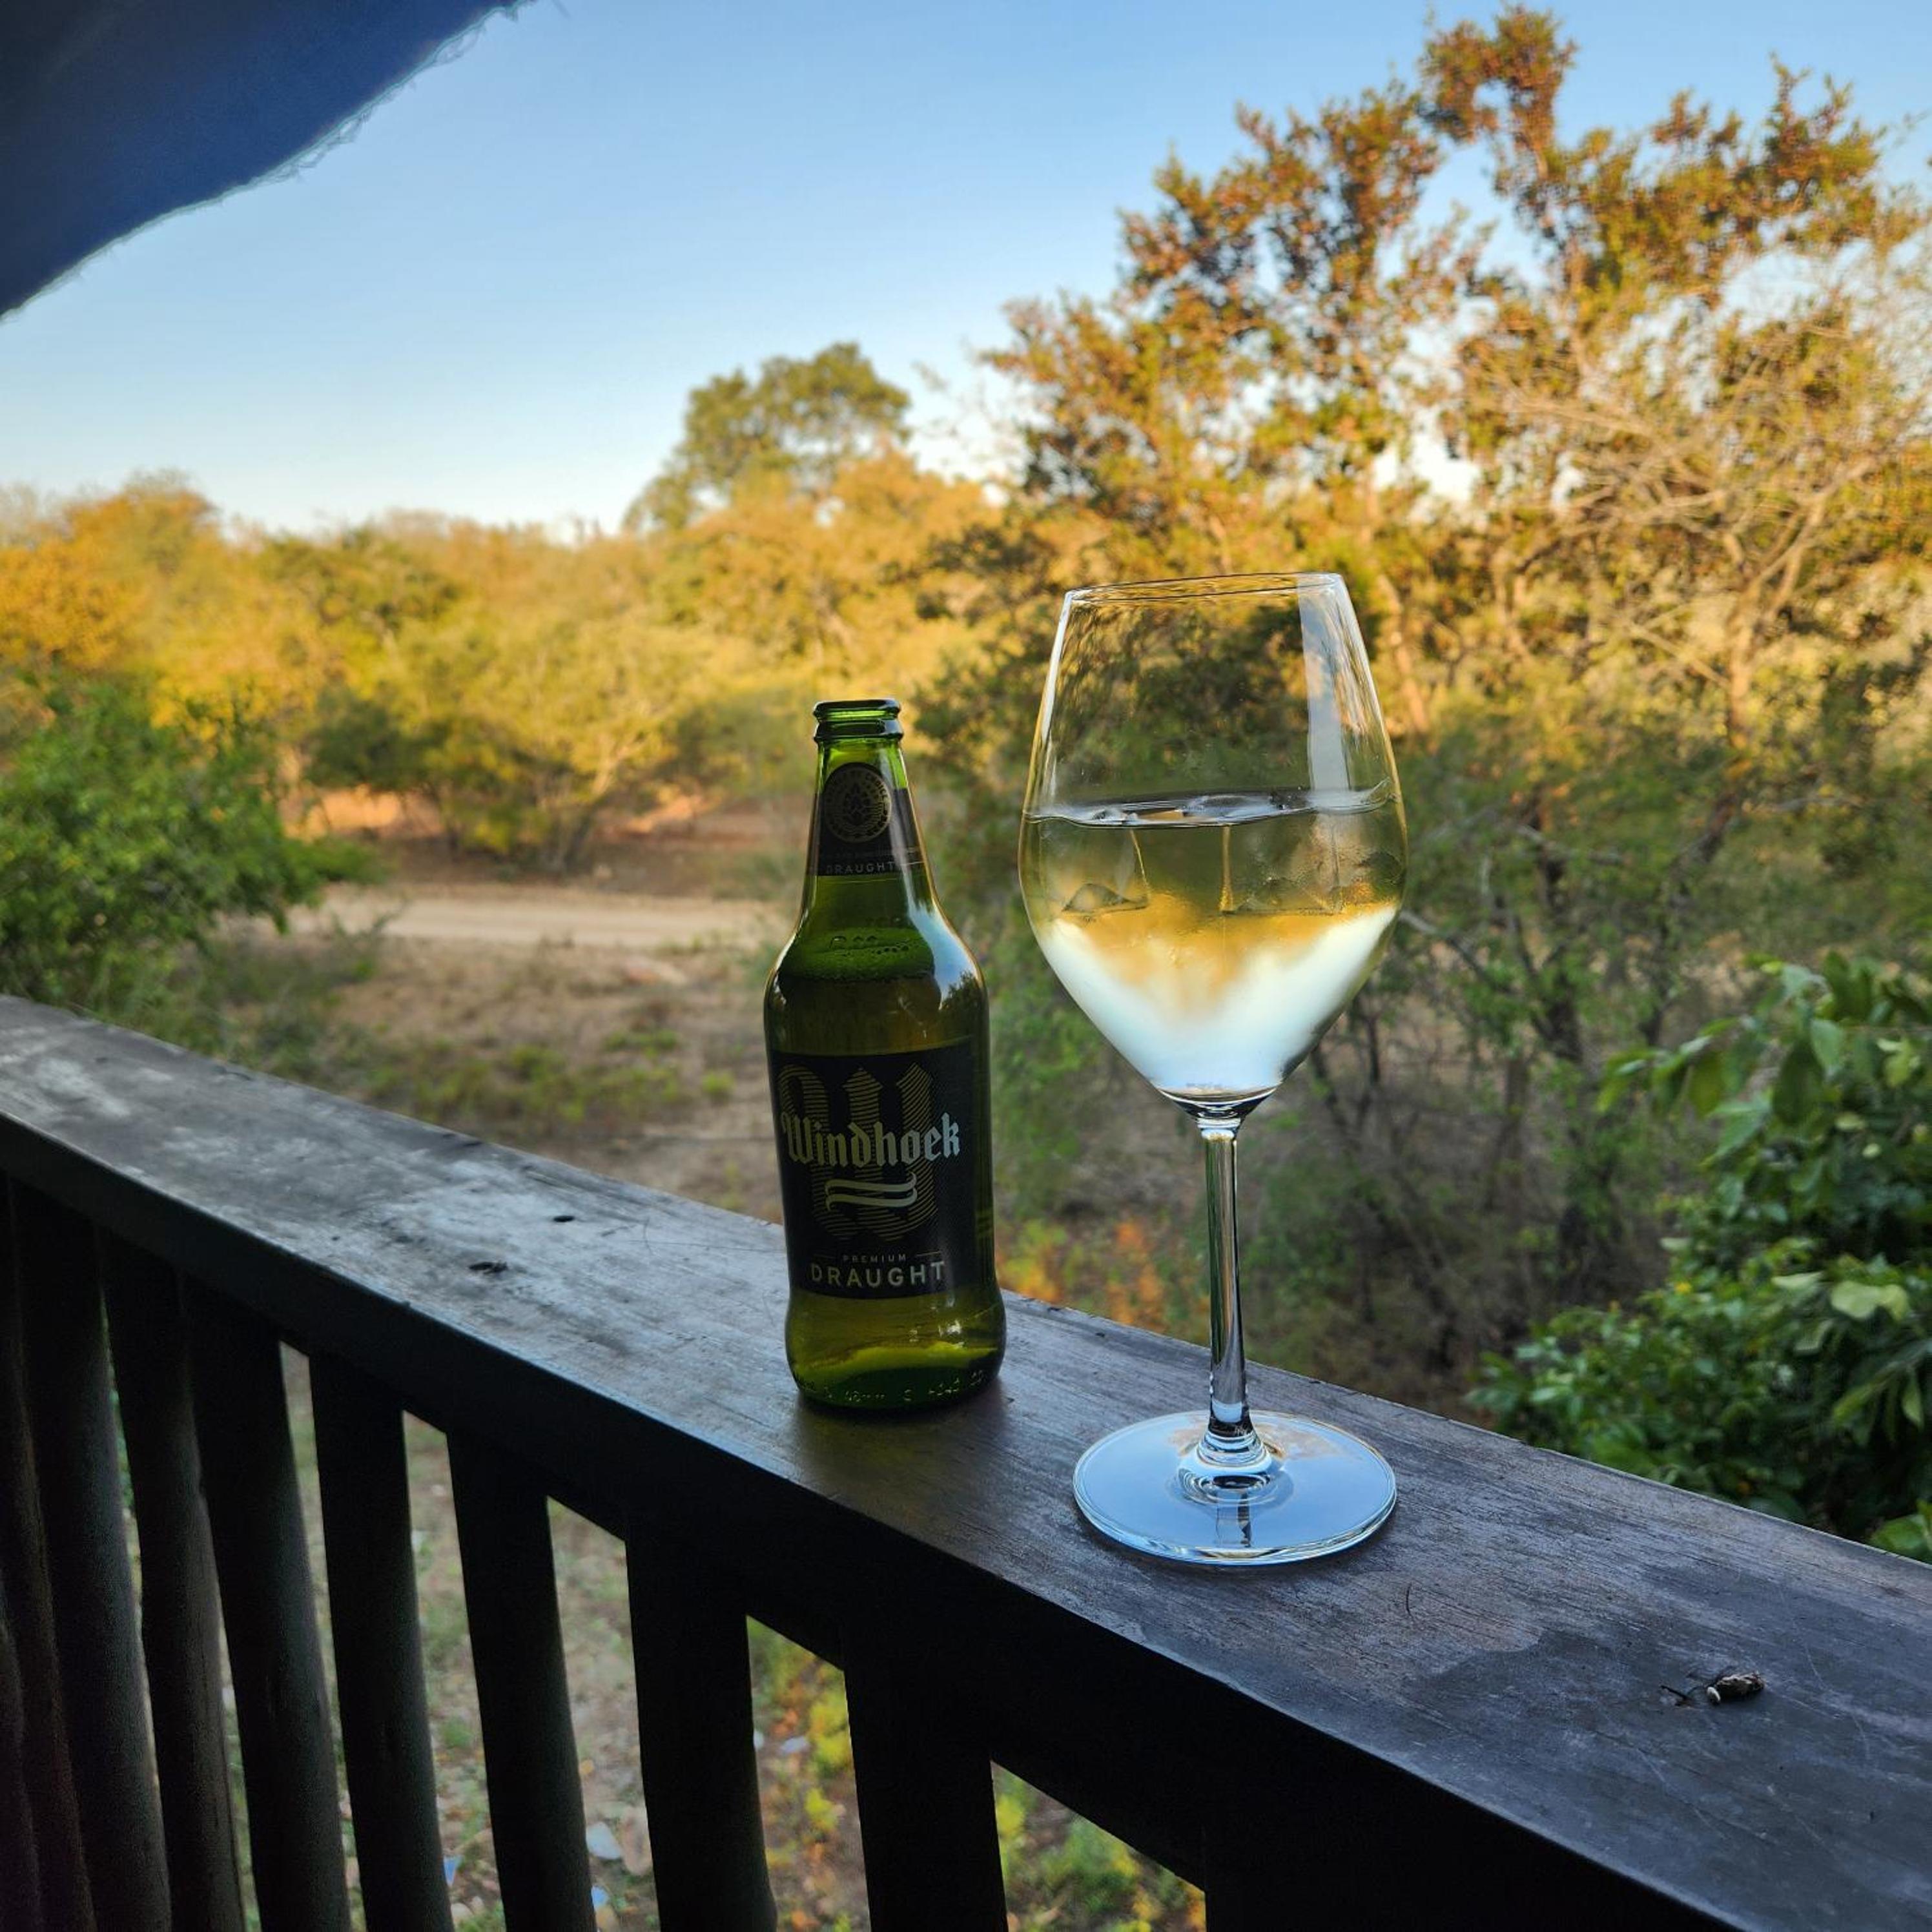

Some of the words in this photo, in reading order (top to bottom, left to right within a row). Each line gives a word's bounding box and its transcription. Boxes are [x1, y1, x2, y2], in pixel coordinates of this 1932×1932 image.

[826, 861, 896, 874] DRAUGHT
[781, 1111, 961, 1167] Windhoek
[843, 1253, 907, 1263] PREMIUM
[810, 1260, 945, 1288] DRAUGHT
